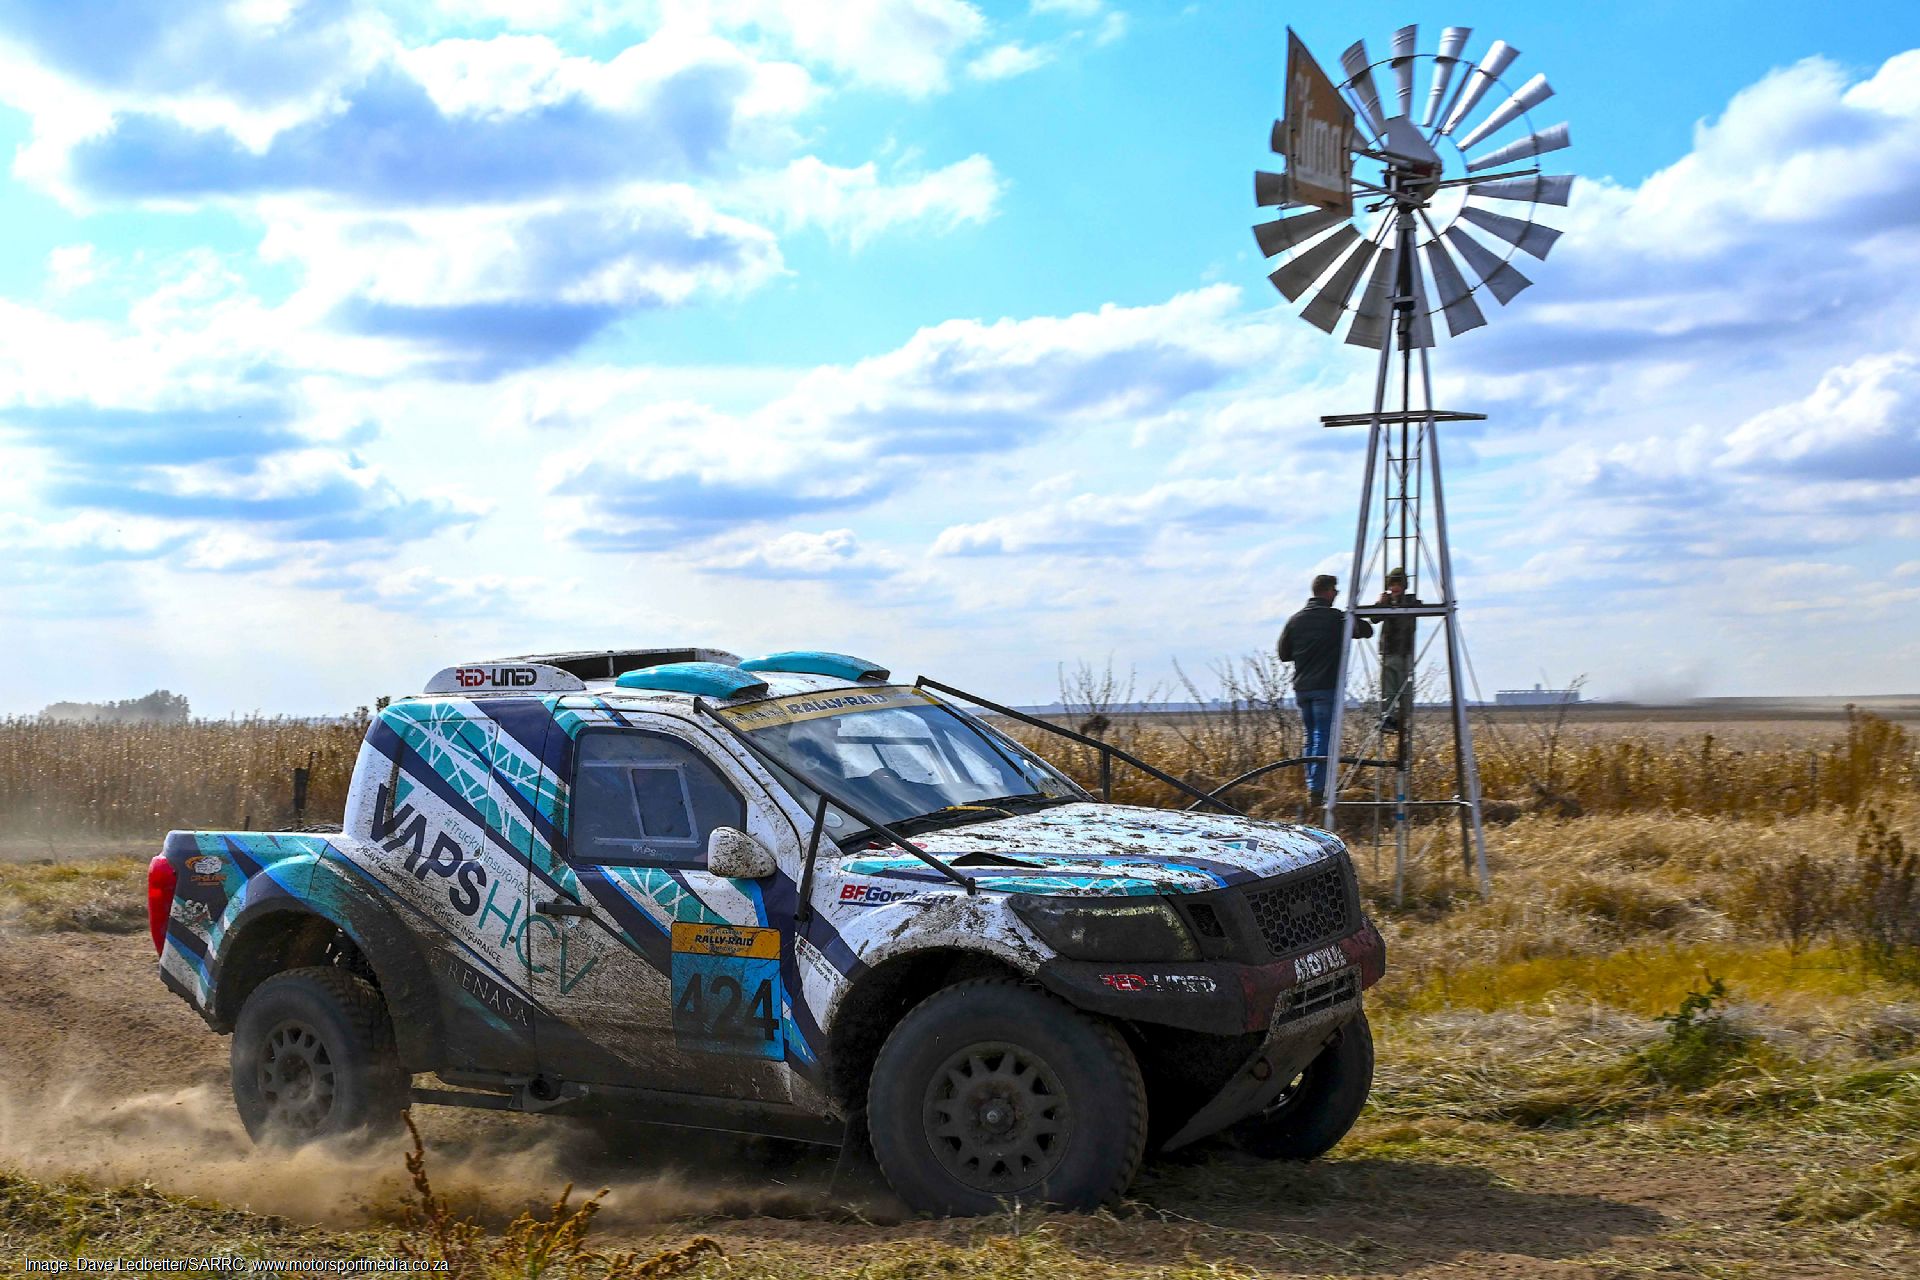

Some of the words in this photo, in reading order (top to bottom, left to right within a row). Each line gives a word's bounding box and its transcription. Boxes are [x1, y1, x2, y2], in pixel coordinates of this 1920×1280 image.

[456, 668, 537, 687] RED-LINED
[786, 694, 889, 714] RALLY-RAID
[840, 884, 957, 903] BFGood
[430, 900, 462, 929] VEHICLE
[459, 923, 502, 963] INSURANCE
[695, 934, 755, 946] RALLY-RAID
[447, 961, 528, 1026] RENASA
[675, 972, 780, 1042] 424
